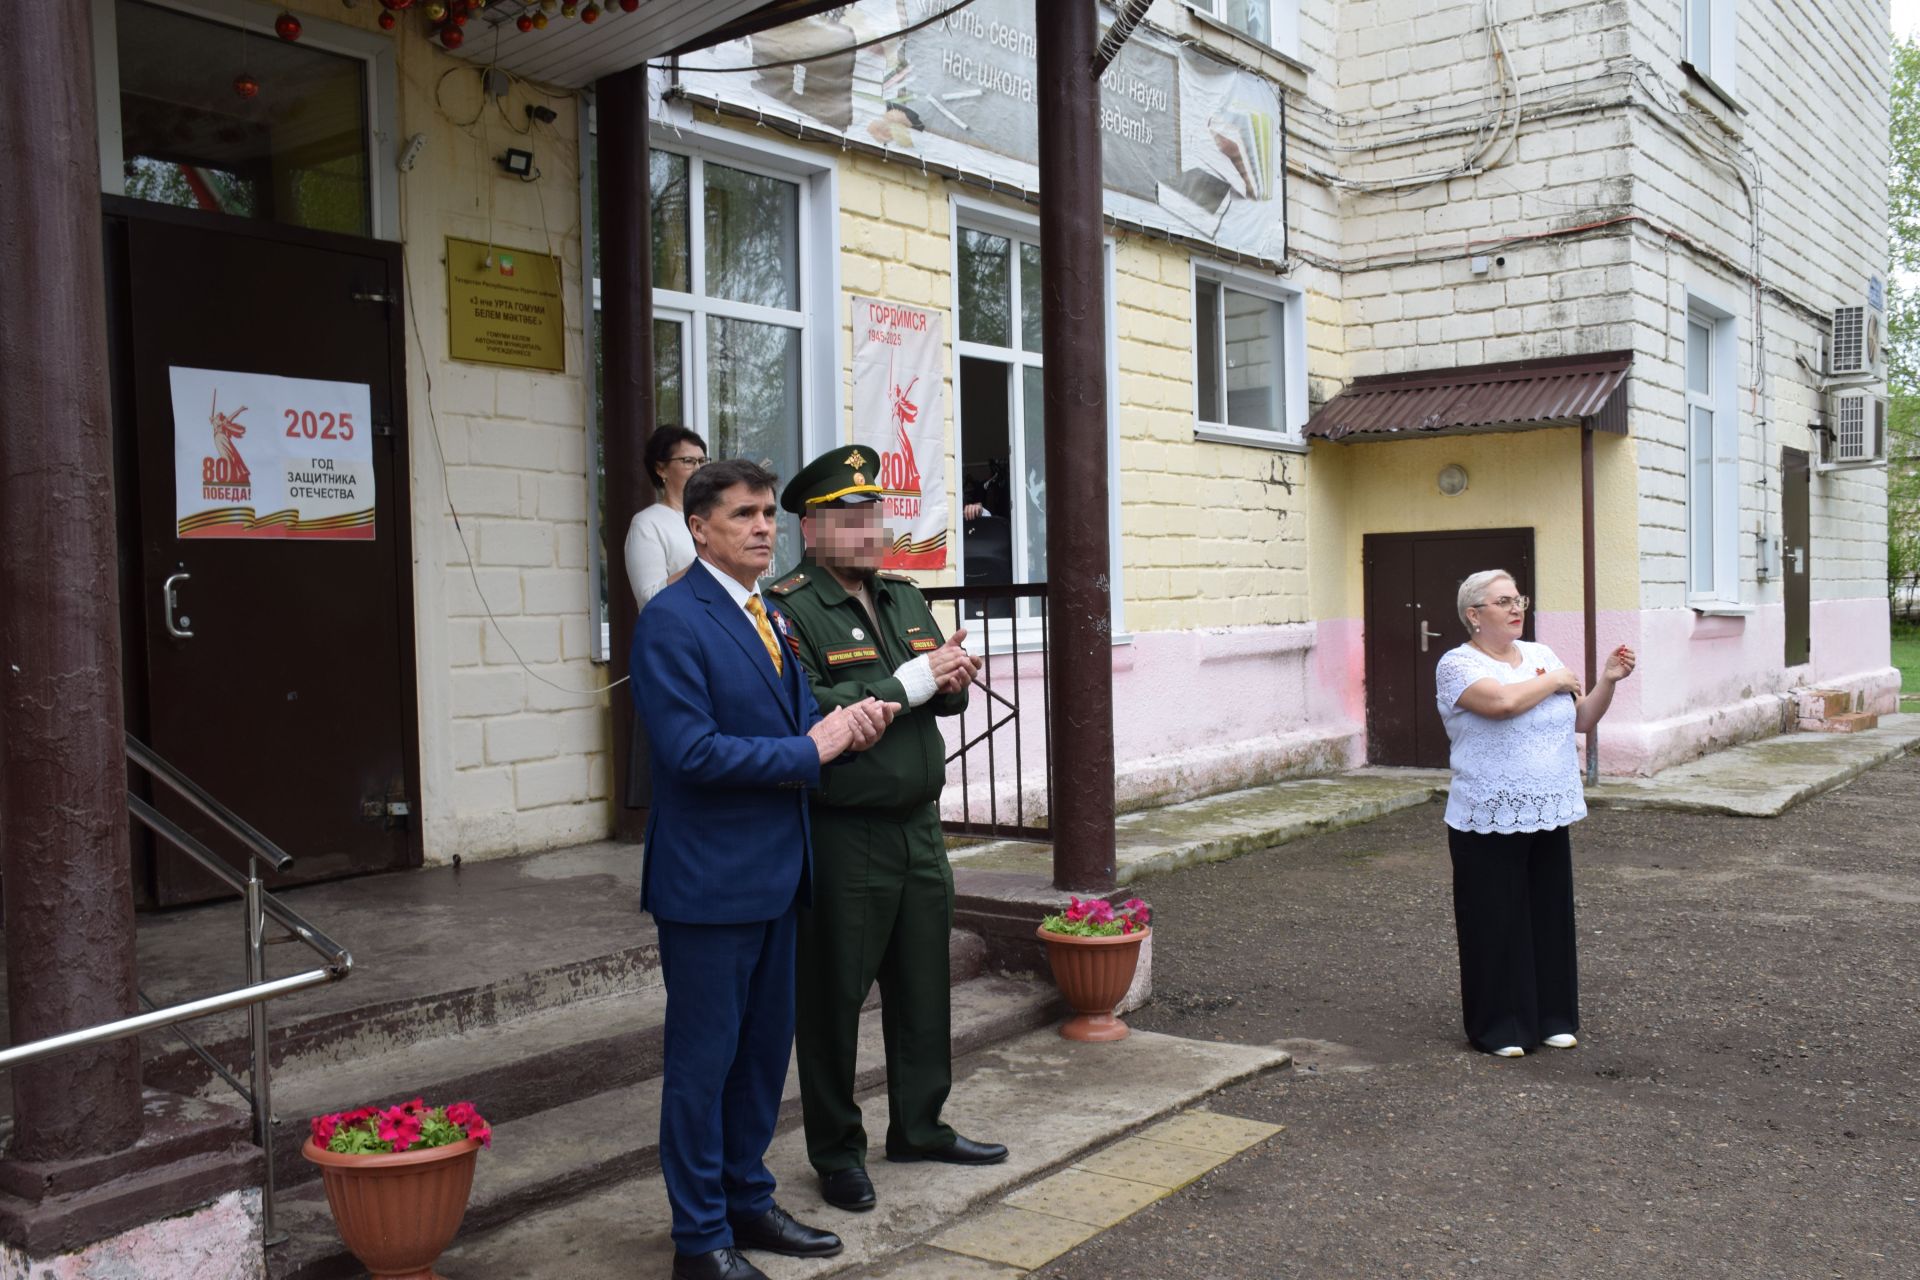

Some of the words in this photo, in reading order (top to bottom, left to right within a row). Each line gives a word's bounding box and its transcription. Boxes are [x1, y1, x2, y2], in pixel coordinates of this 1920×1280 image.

[942, 48, 973, 81] нас
[978, 62, 1032, 102] школа
[1128, 78, 1167, 112] науки
[474, 308, 502, 321] БЕЛЕМ
[494, 299, 513, 310] УРТА
[514, 301, 545, 315] ГОМУМИ
[868, 303, 927, 332] ГОРДИМСЯ
[867, 328, 902, 347] 1945-2025
[284, 408, 355, 441] 2025
[203, 456, 228, 484] 80
[311, 458, 334, 471] ГОД
[881, 451, 903, 490] 80
[287, 471, 357, 486] ЗАЩИТНИКА
[203, 486, 252, 502] ПОБЕДА!
[290, 486, 355, 500] ОТЕЧЕСТВА
[881, 496, 922, 519] БЕДА!
